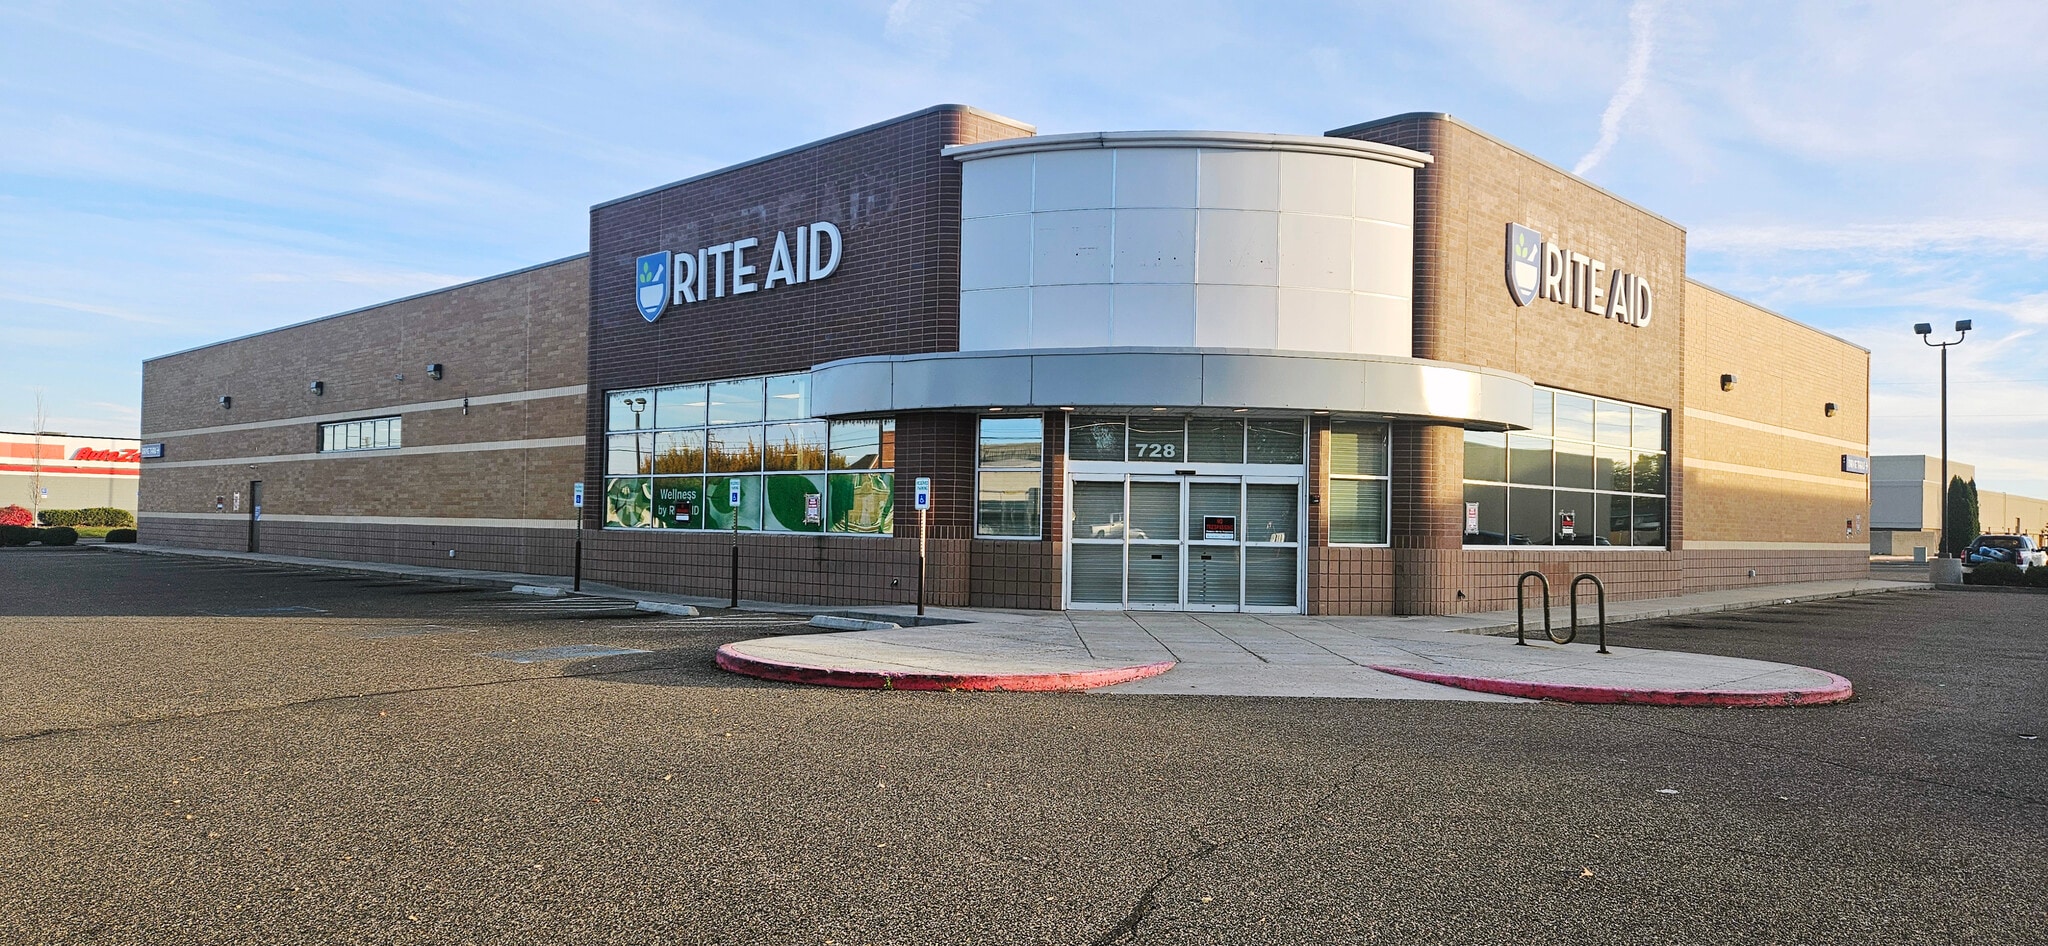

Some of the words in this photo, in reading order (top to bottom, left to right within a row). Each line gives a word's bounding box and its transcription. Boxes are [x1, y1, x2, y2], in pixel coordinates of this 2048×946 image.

[673, 237, 758, 305] RITE
[764, 221, 842, 289] AID
[1540, 242, 1605, 316] RITE
[1606, 269, 1652, 328] AID
[1135, 443, 1176, 458] 728
[660, 488, 697, 500] Wellness
[658, 504, 667, 517] by
